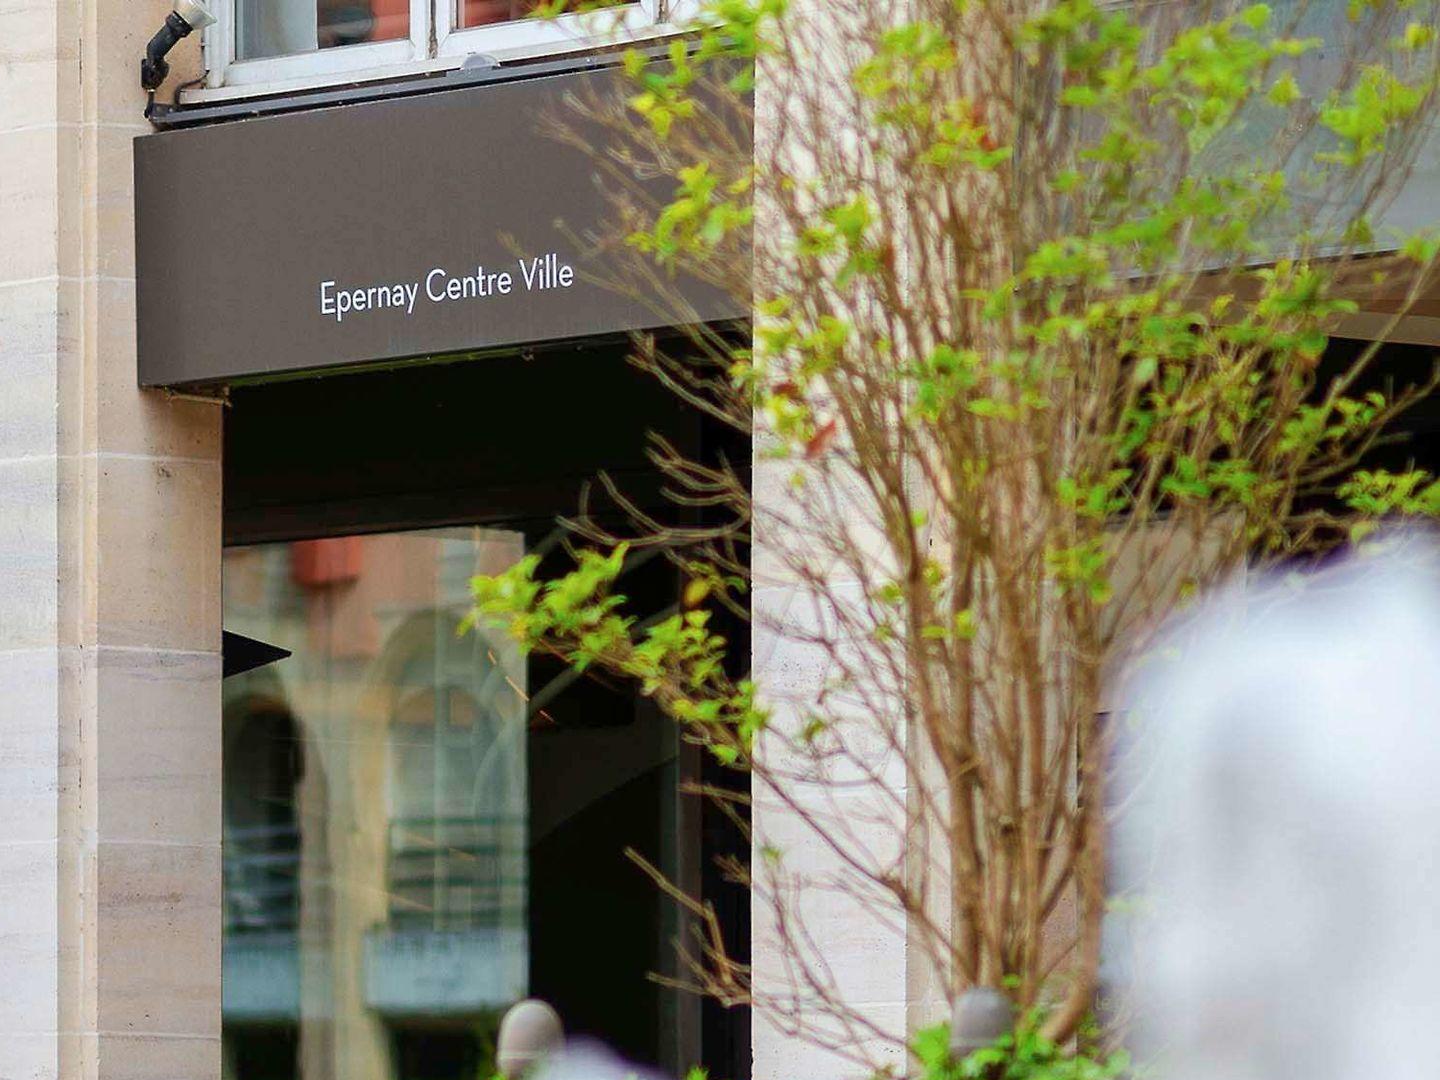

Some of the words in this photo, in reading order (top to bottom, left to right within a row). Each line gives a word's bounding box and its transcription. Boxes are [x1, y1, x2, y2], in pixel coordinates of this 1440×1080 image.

[320, 280, 419, 321] Epernay
[425, 265, 512, 302] Centre
[518, 253, 574, 291] Ville
